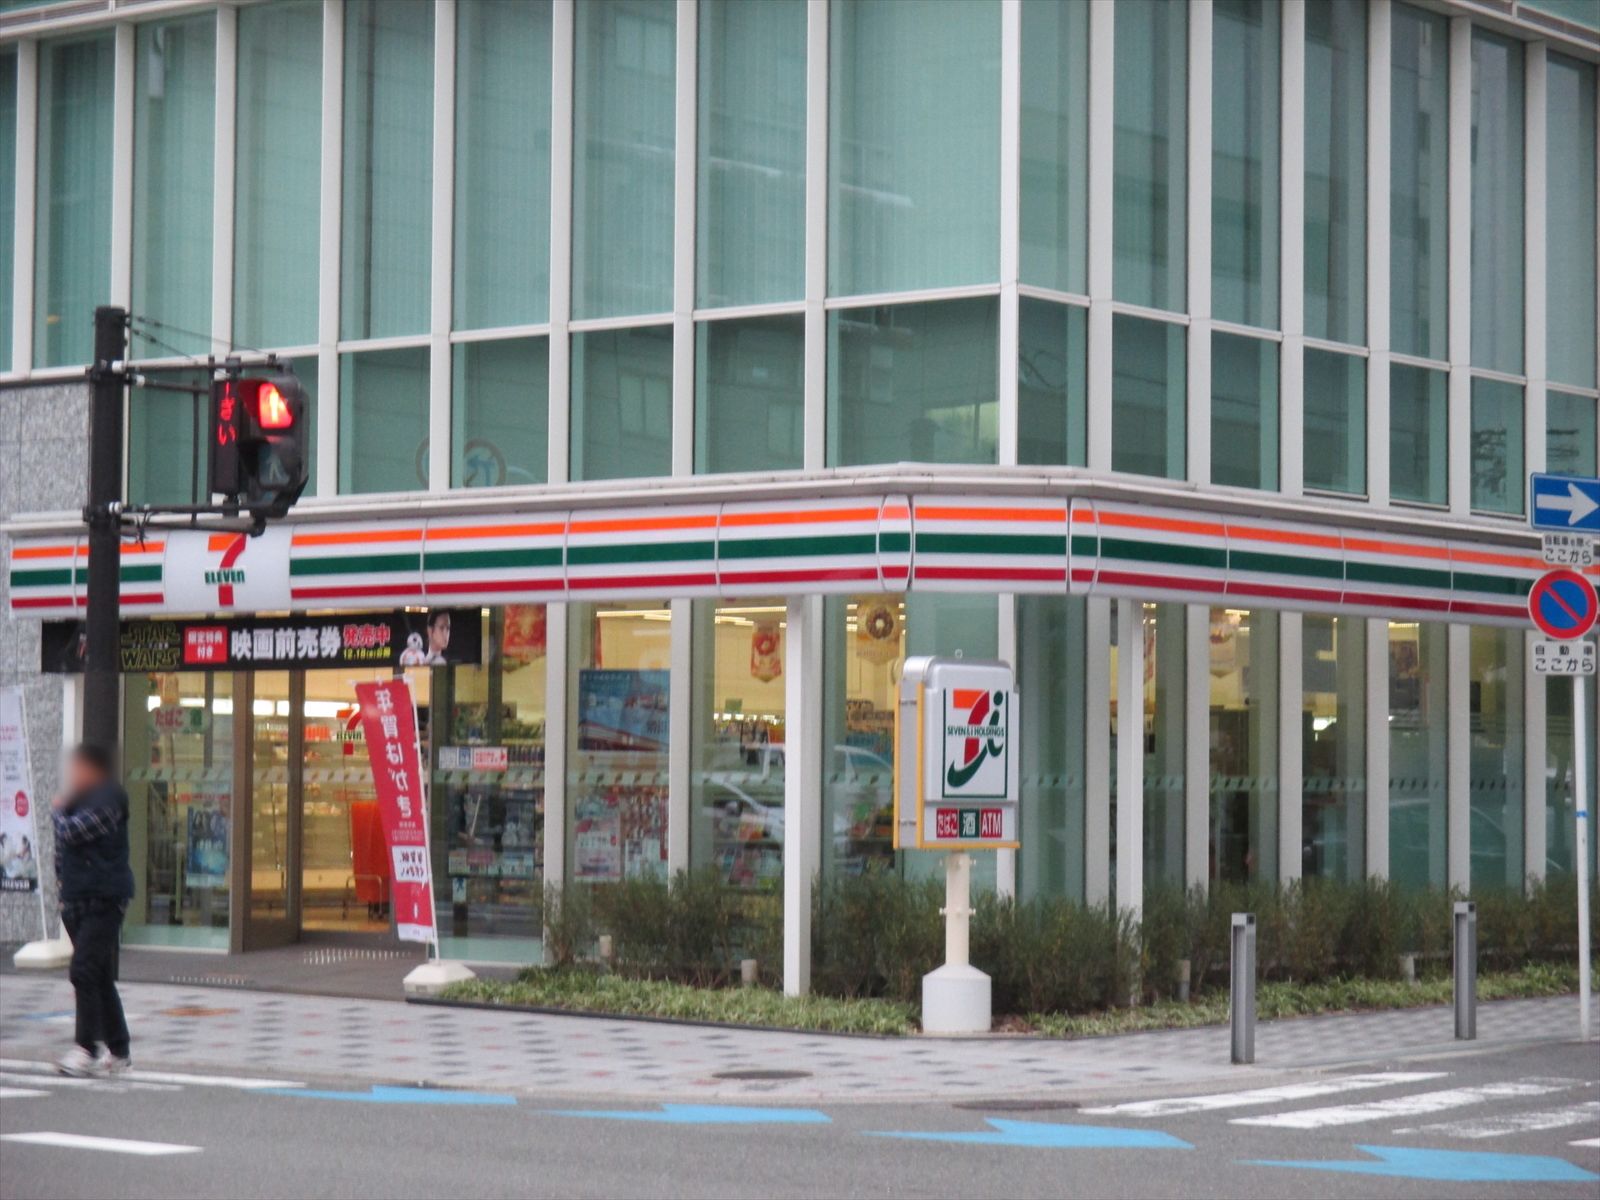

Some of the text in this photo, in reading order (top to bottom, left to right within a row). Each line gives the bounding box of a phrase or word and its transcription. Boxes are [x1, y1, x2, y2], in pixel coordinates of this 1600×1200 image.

[1545, 547, 1592, 565] ここから
[231, 625, 341, 661] 映画前売券
[343, 622, 391, 648] 発売中
[1535, 645, 1593, 656] 自動車
[1535, 657, 1593, 673] ここから
[937, 812, 976, 836] たばこ 酒
[981, 812, 1001, 835] ATM
